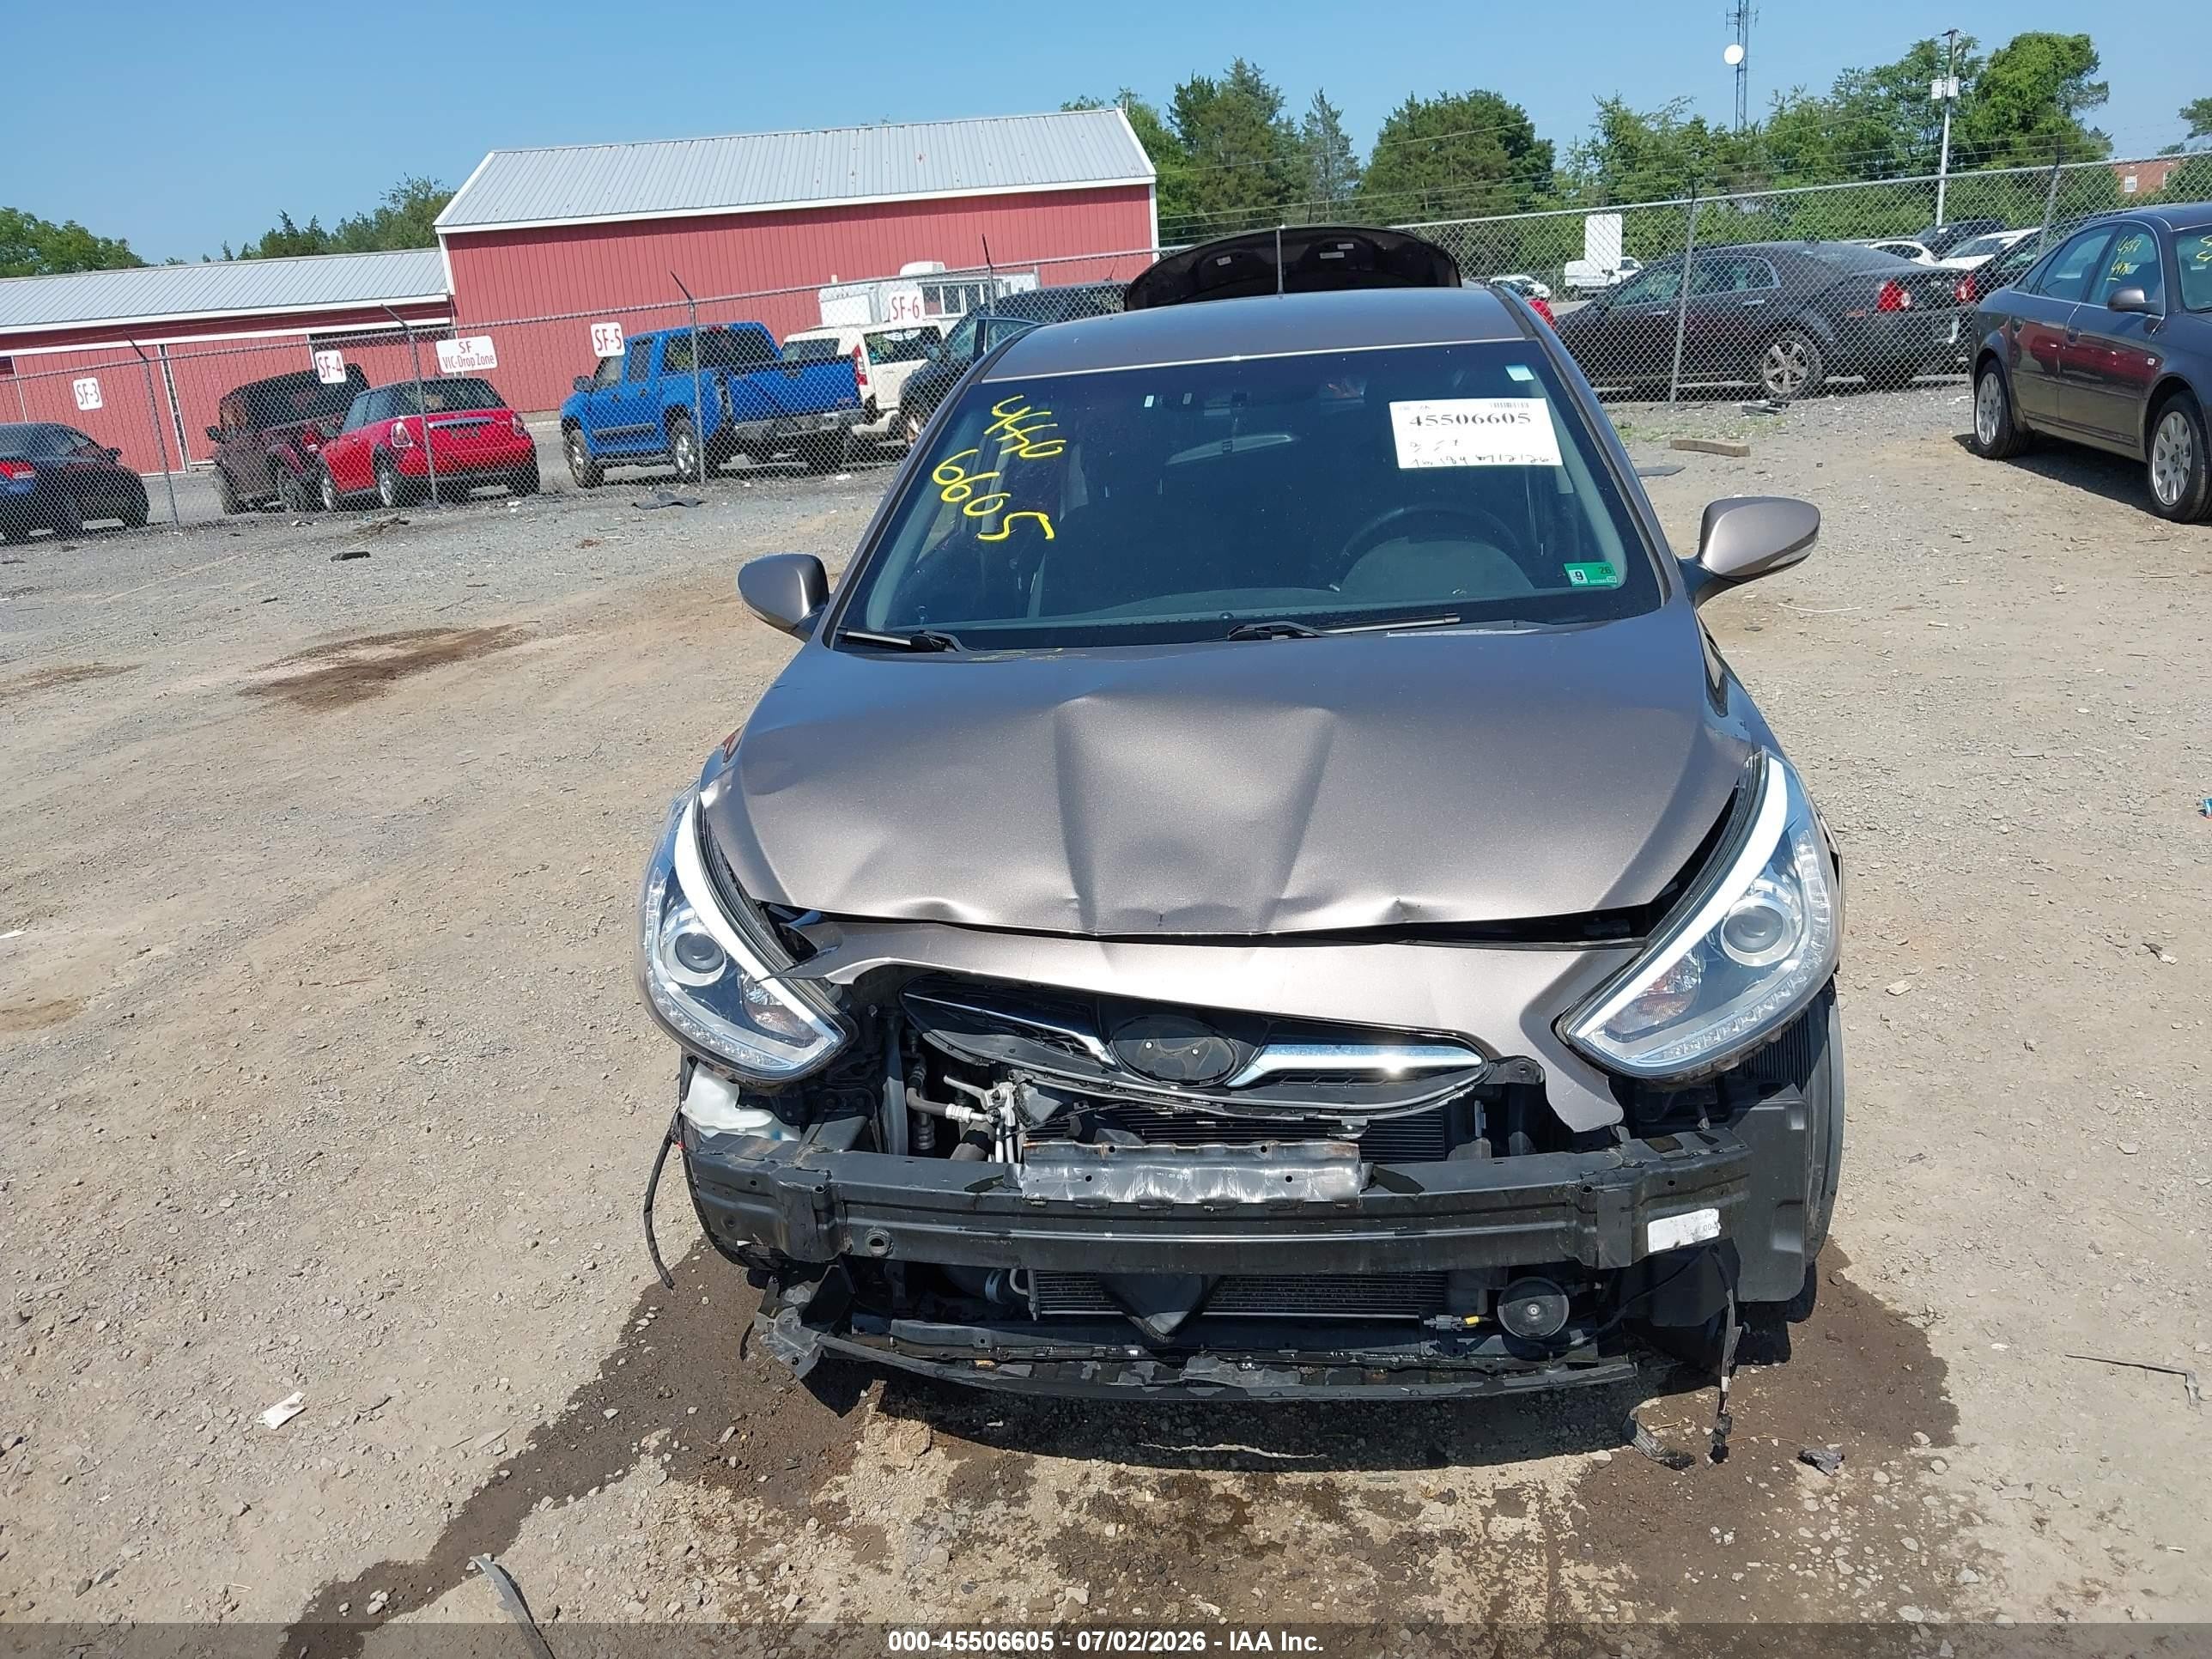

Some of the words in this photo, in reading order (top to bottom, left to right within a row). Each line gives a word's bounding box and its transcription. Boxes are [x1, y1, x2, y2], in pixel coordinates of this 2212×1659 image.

[892, 295, 920, 319] SF-6
[459, 341, 471, 354] SF
[595, 328, 622, 351] SF-5
[318, 356, 343, 378] SF-4
[442, 355, 475, 369] VIC-Drop
[475, 353, 495, 366] Zone
[76, 382, 100, 405] SF-3
[1409, 413, 1531, 426] 45506605
[1575, 571, 1583, 580] 9
